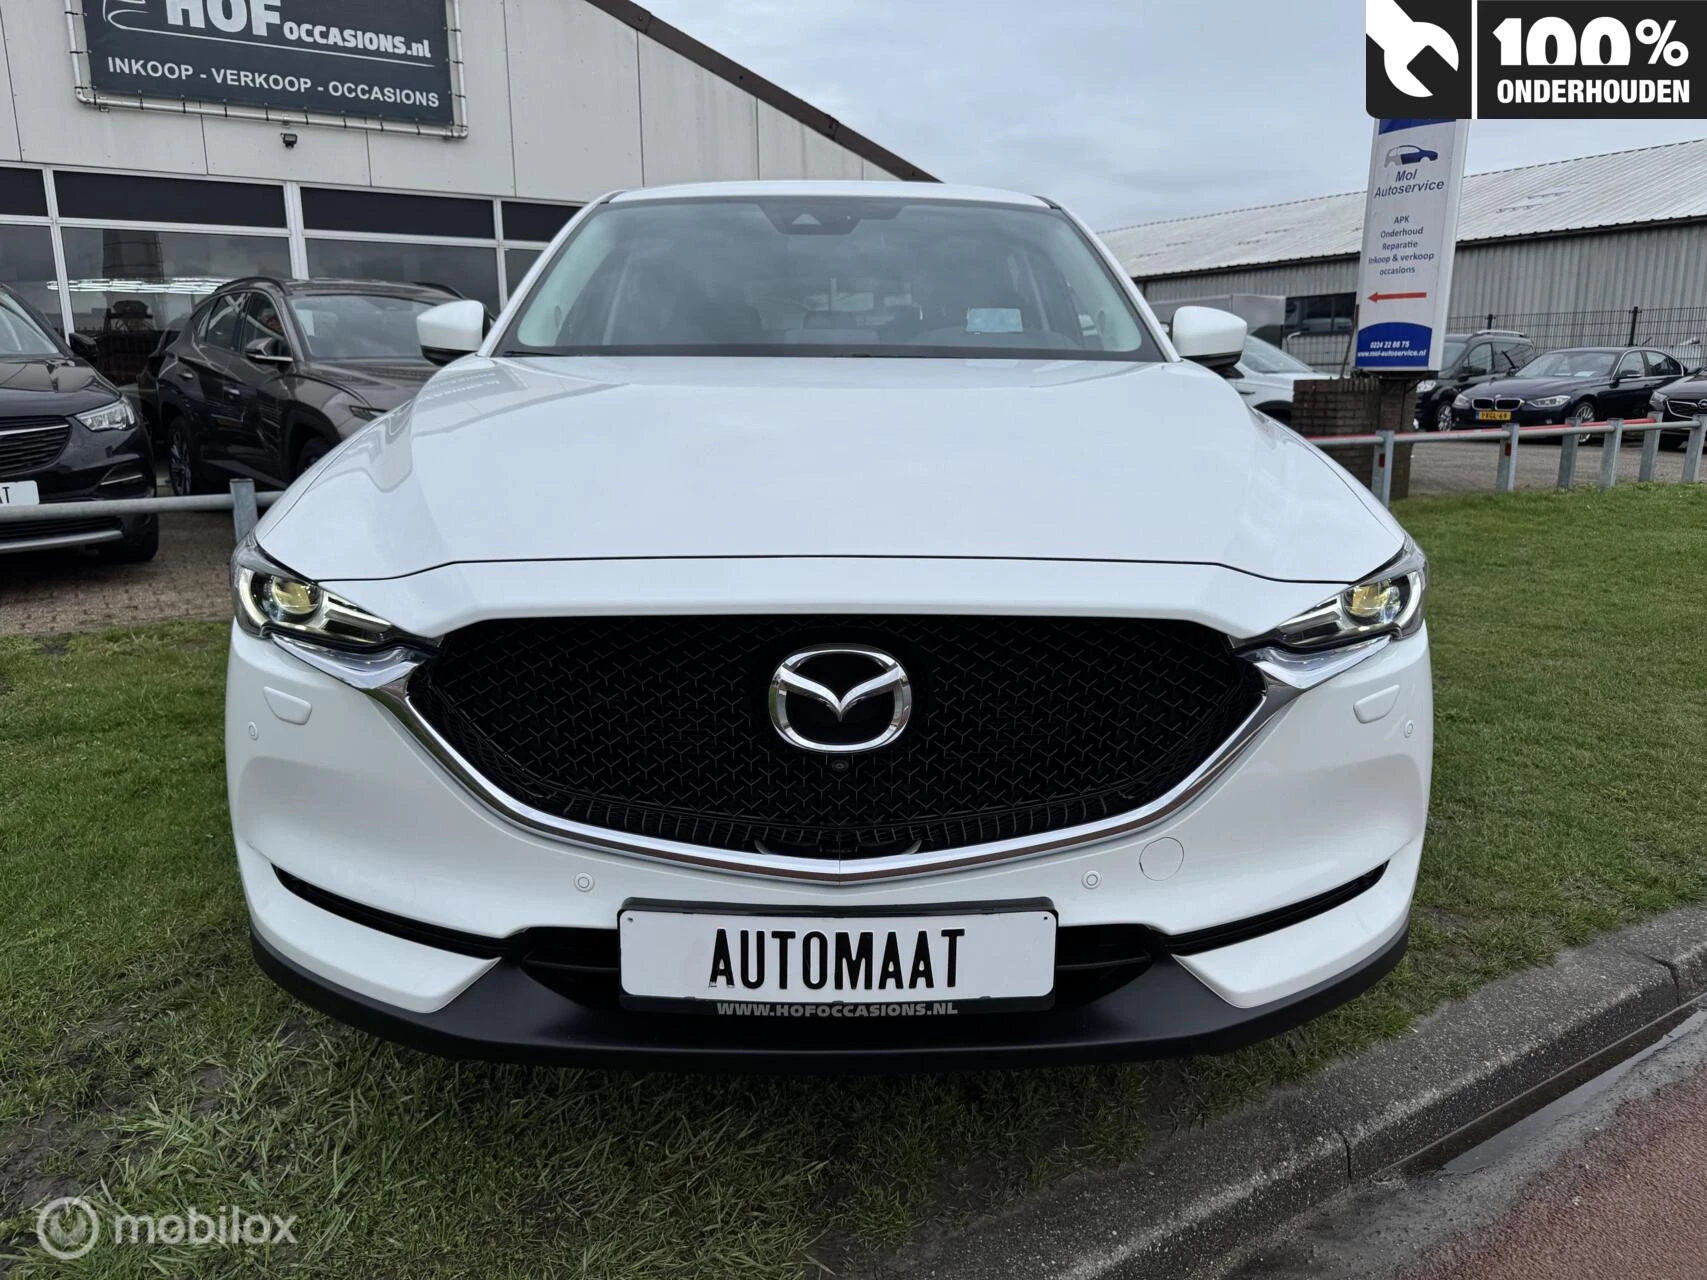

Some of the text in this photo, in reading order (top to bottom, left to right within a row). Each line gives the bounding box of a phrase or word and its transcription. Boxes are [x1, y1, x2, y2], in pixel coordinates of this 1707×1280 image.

[108, 56, 193, 80] INKOOP
[211, 68, 312, 93] VERKOOP
[328, 81, 439, 107] OCCASIONS
[1395, 169, 1418, 182] Mol
[1374, 180, 1445, 198] Autoservice
[1394, 215, 1410, 224] APK
[1380, 226, 1424, 239] Onderhoud
[1382, 240, 1418, 252] Reparatie
[1392, 254, 1398, 262] &
[1400, 252, 1435, 262] verkoop
[1379, 266, 1416, 276] occasions
[708, 928, 966, 990] AUTOMAAT
[716, 1002, 958, 1018] WWW.HOFOCCASIONS.NL
